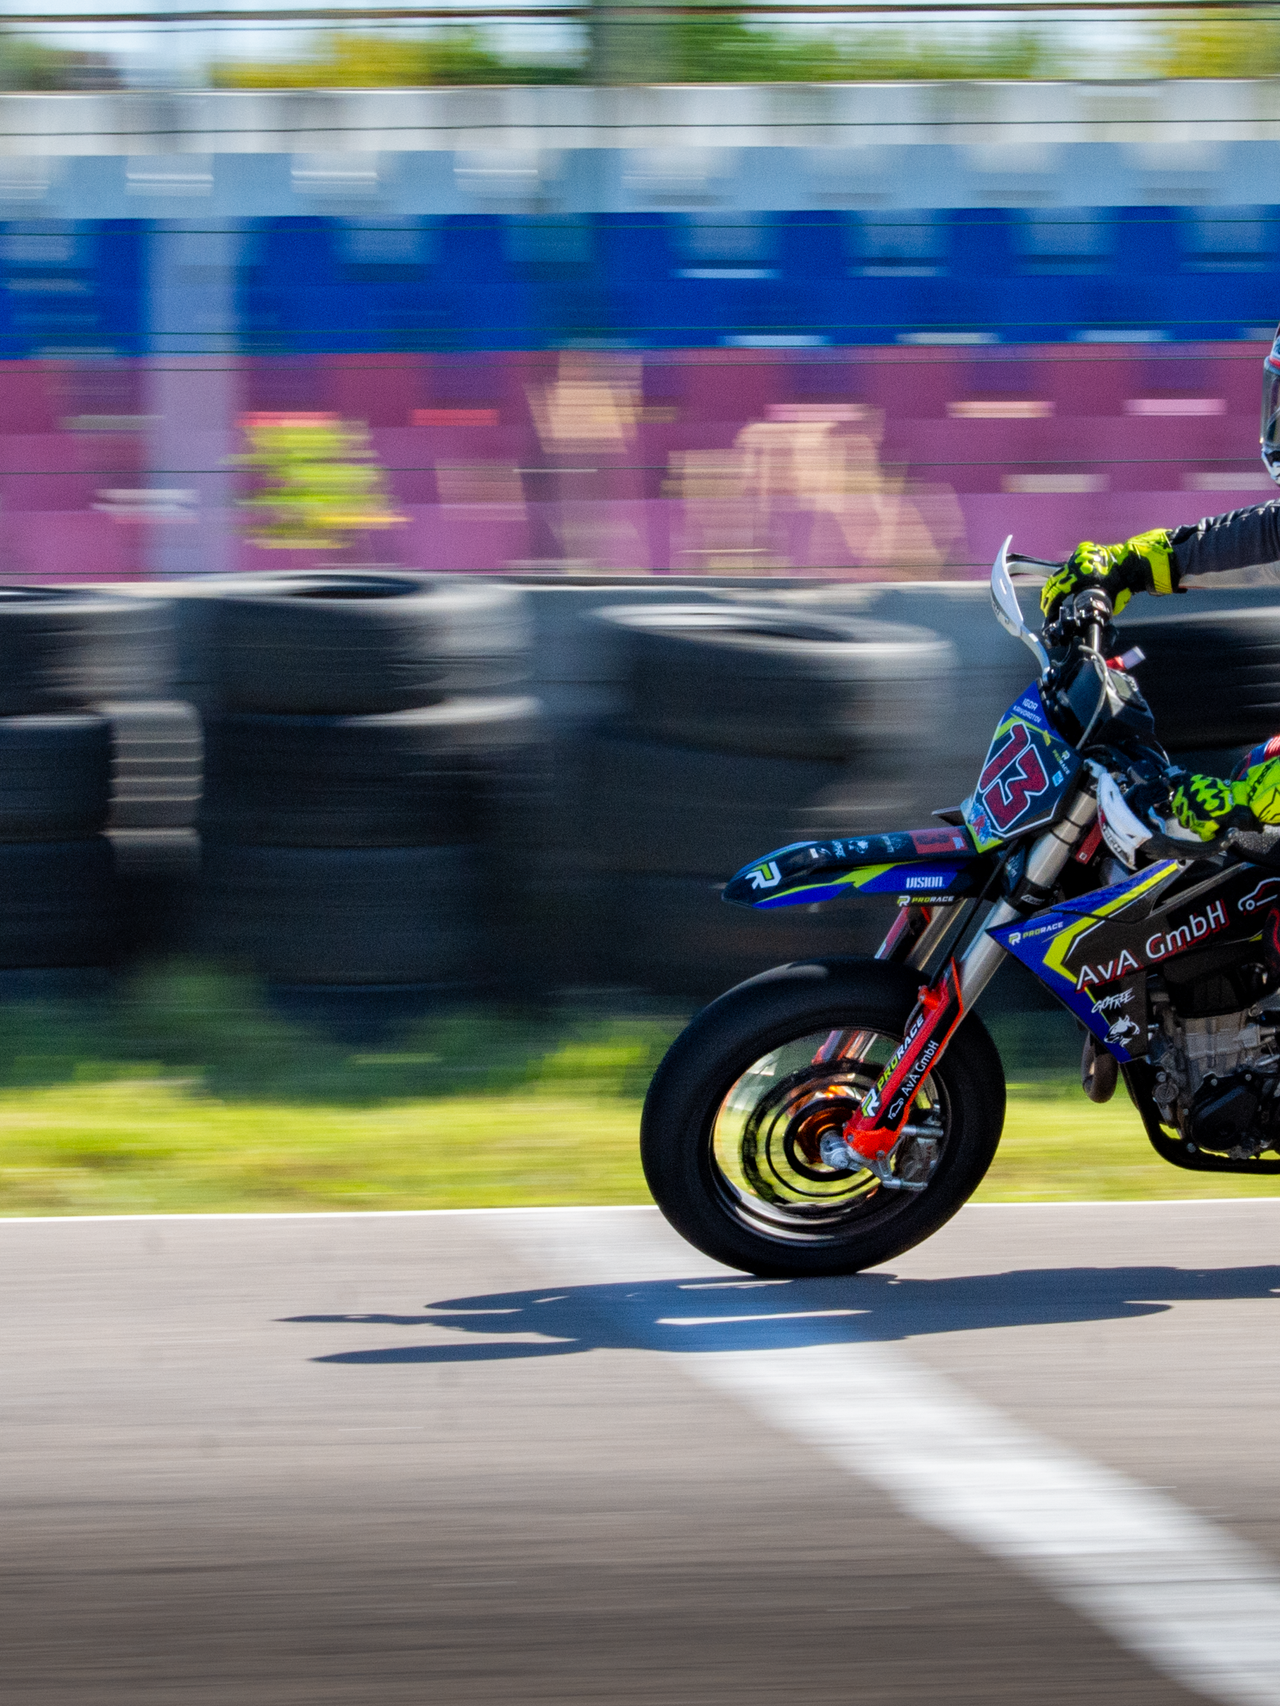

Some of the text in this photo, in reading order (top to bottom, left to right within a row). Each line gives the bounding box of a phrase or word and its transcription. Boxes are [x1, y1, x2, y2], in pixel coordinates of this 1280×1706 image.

[1022, 698, 1038, 711] IGOR
[978, 721, 1050, 833] 13
[1022, 921, 1064, 939] PRORACE
[1076, 899, 1229, 991] AvA GmbH
[876, 1013, 925, 1092] PRORACE
[901, 1040, 940, 1097] AvA GmbH
